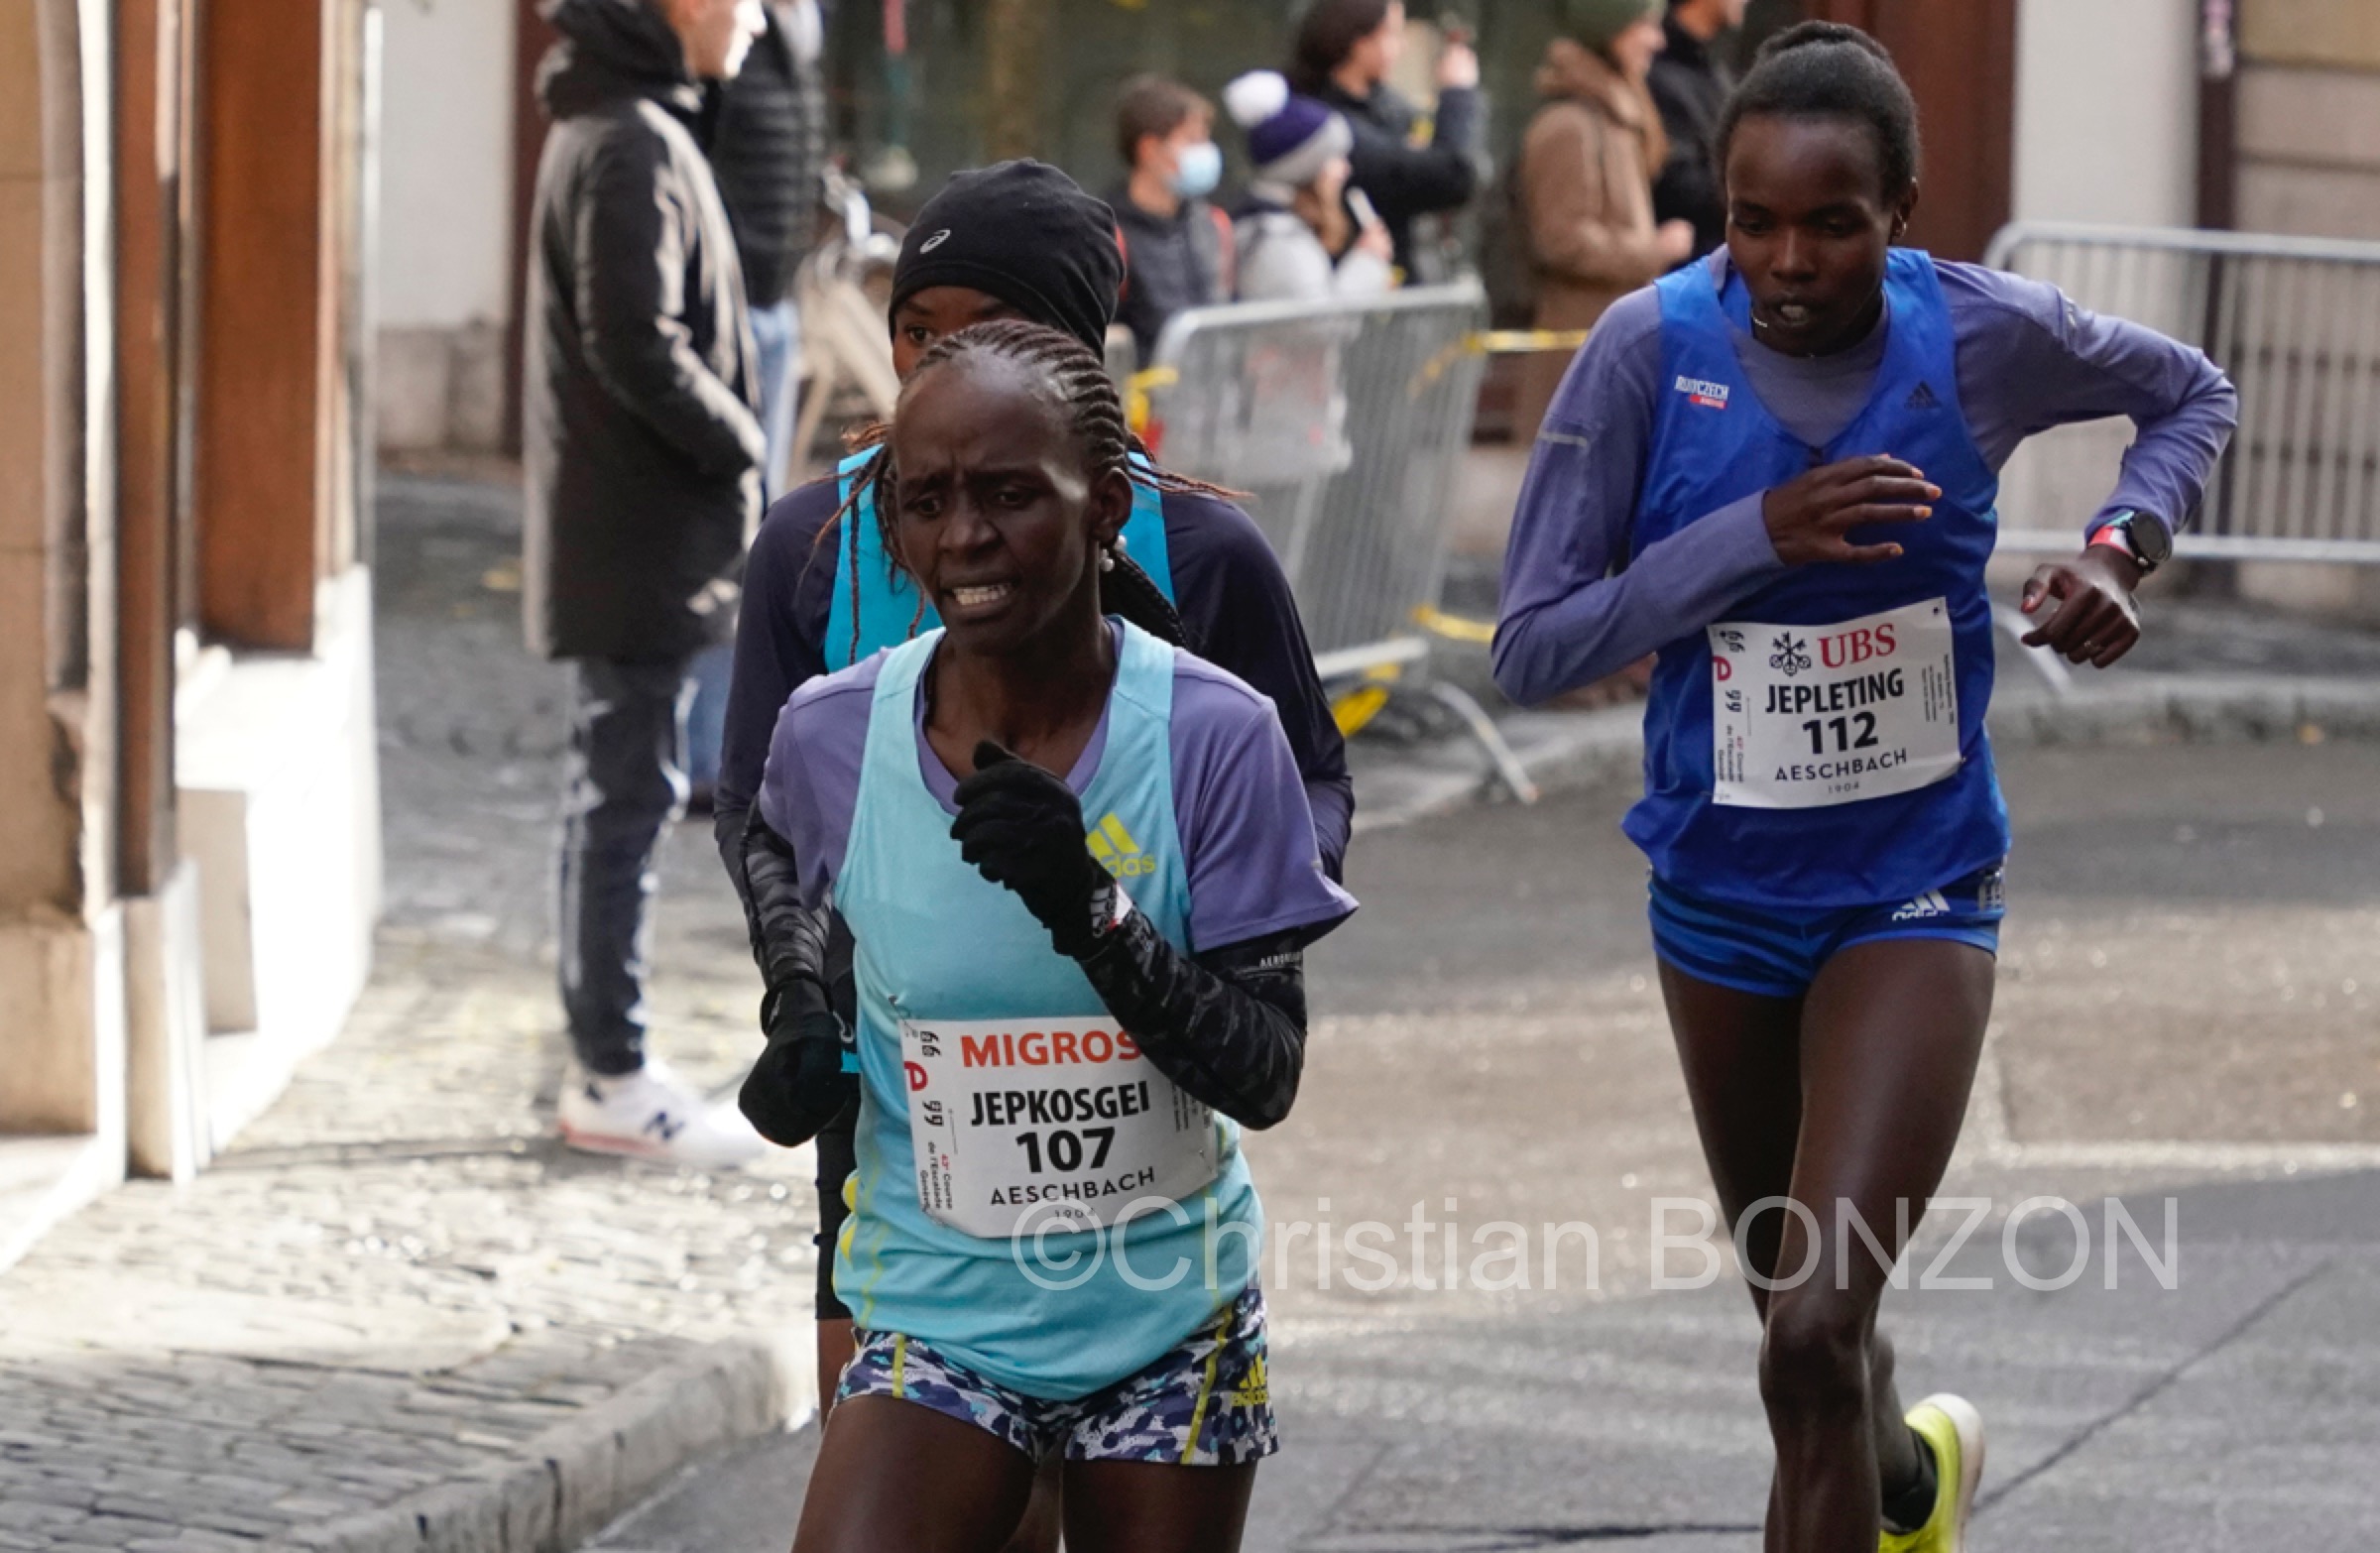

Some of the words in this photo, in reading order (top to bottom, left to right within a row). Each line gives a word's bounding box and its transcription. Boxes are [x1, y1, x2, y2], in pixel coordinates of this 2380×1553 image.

[1817, 623, 1897, 669] UBS
[1765, 667, 1904, 714] JEPLETING
[1802, 711, 1878, 755] 112
[1775, 748, 1907, 781] AESCHBACH
[961, 1030, 1141, 1068] MIGROS
[970, 1080, 1150, 1127] JEPKOSGEI
[1015, 1126, 1116, 1174] 107
[990, 1166, 1155, 1207] AESCHBACH
